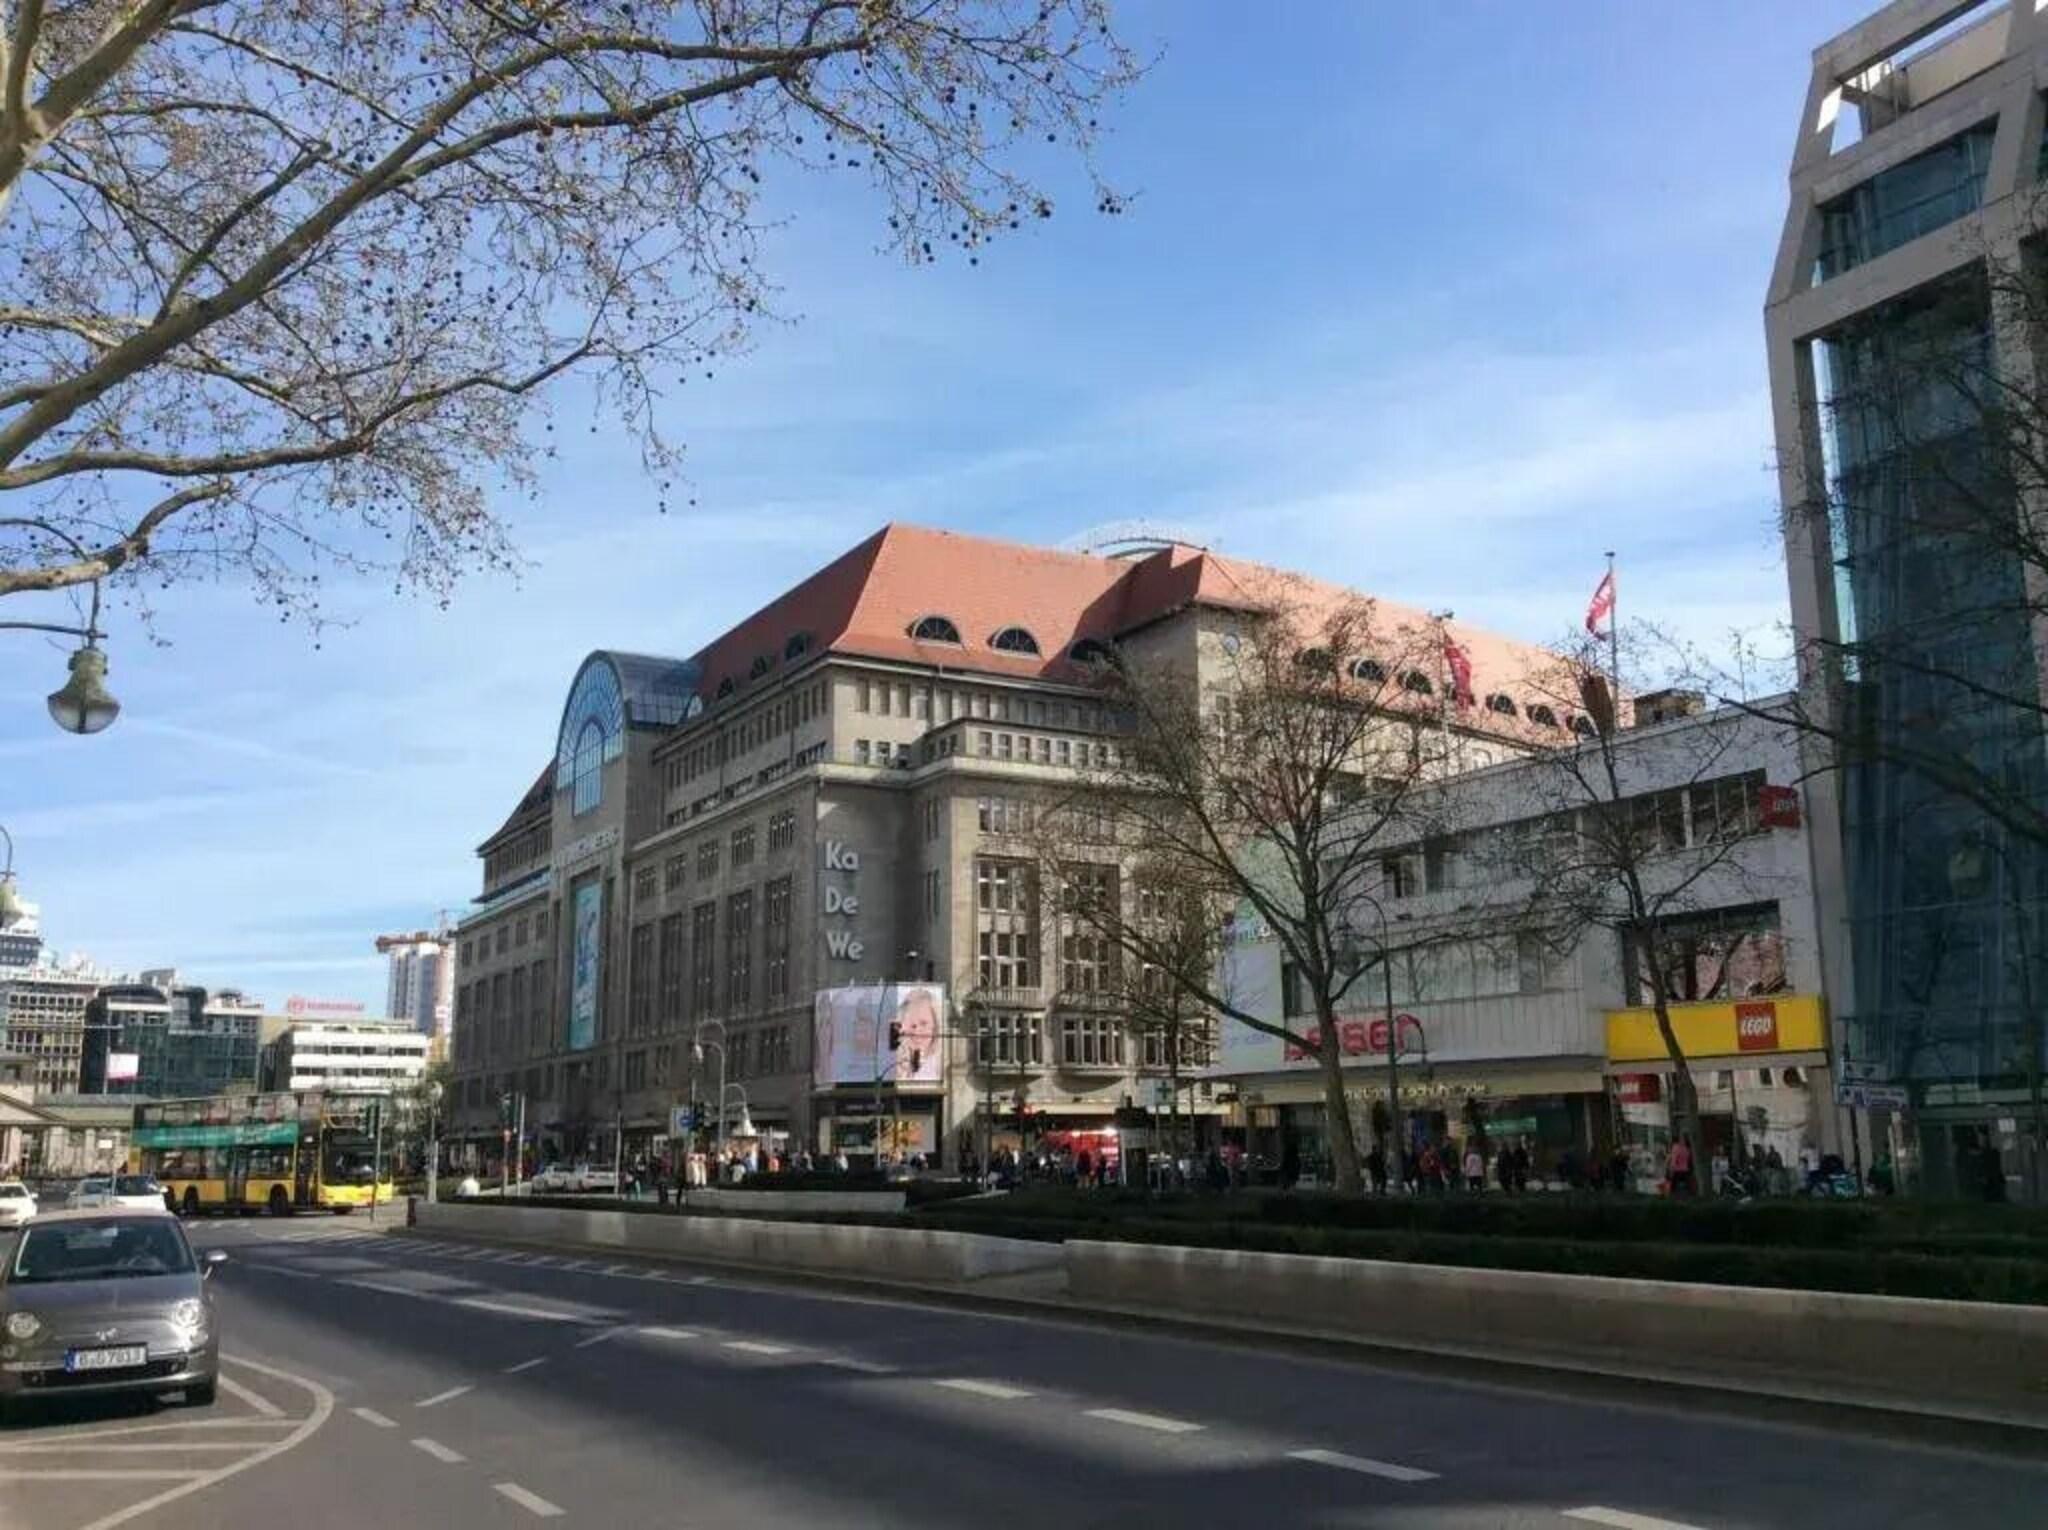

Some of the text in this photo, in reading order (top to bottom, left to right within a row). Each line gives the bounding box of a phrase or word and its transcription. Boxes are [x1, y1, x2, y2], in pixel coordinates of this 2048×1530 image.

[825, 840, 860, 870] Ka
[825, 886, 859, 914] De
[826, 932, 864, 960] We
[1741, 1016, 1771, 1036] LEGO
